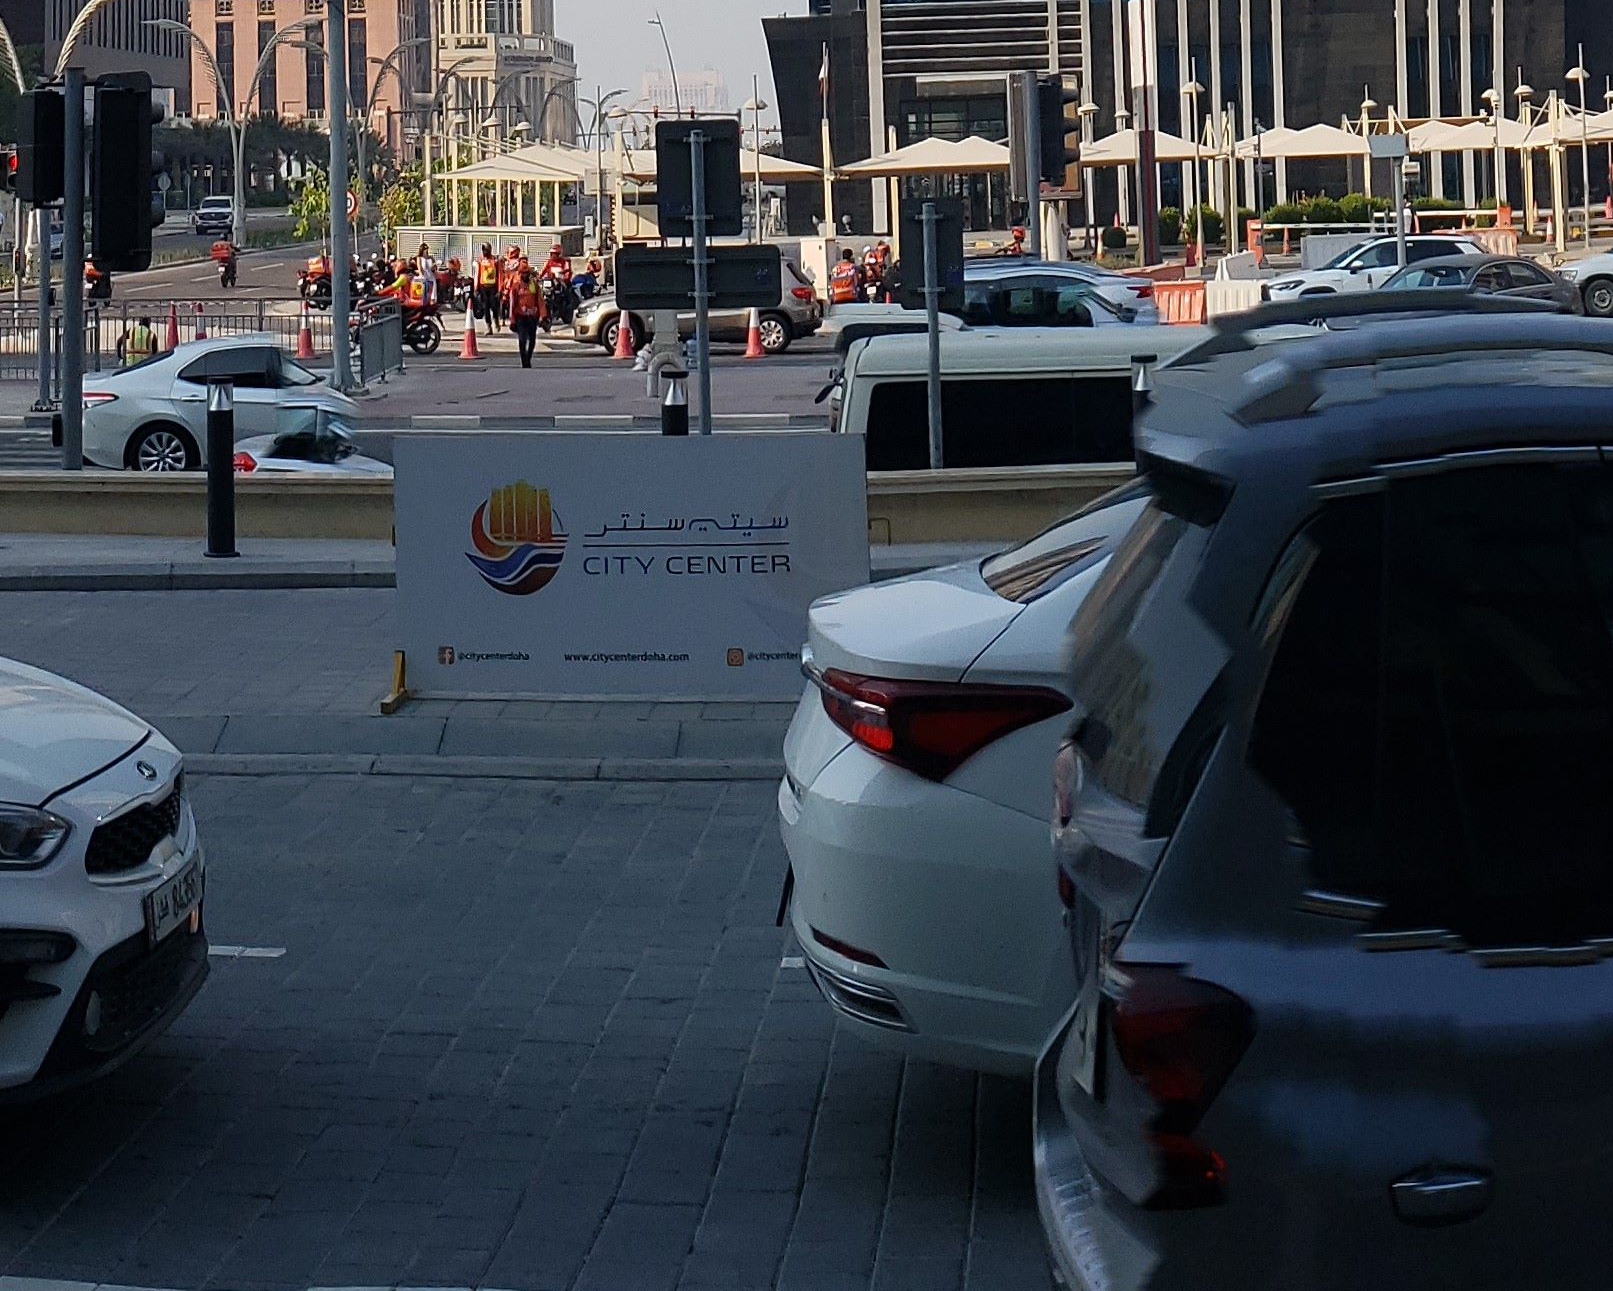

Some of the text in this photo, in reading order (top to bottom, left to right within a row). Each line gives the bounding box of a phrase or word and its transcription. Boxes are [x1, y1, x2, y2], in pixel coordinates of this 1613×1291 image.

[583, 513, 790, 538] سيتي سنتر
[582, 554, 791, 576] CITY CENTER
[563, 650, 690, 664] www.citycenterdoha.com
